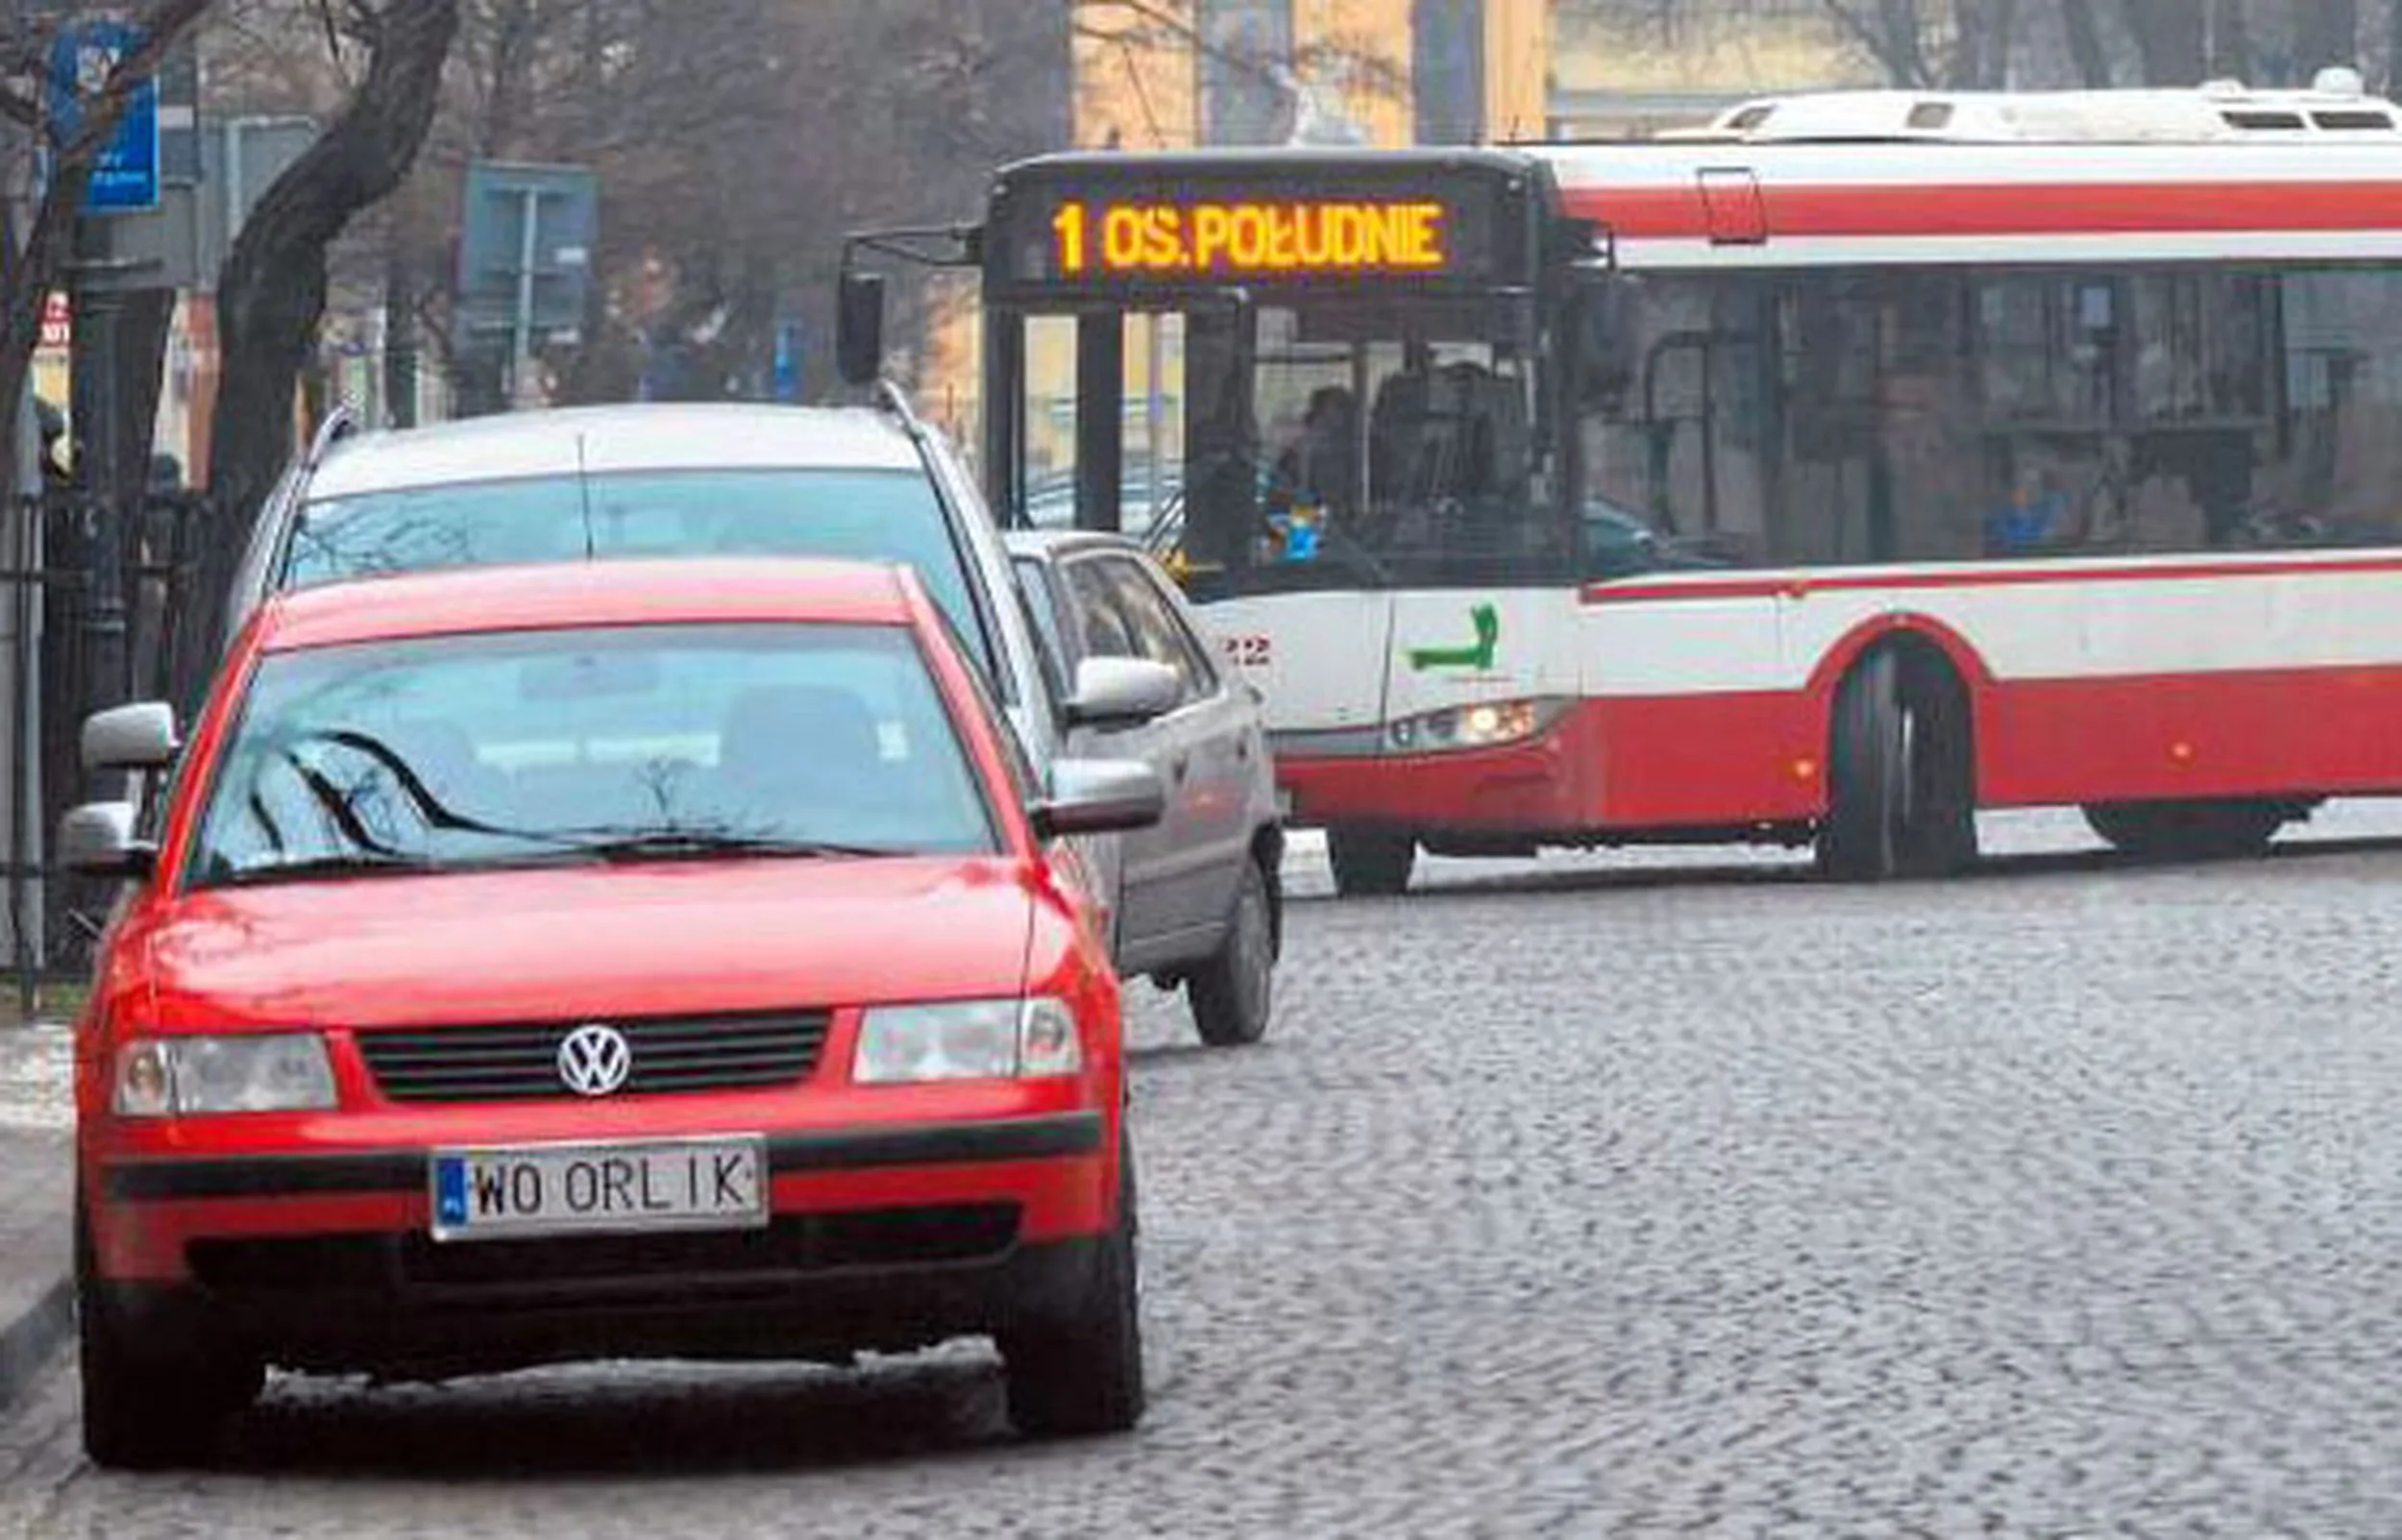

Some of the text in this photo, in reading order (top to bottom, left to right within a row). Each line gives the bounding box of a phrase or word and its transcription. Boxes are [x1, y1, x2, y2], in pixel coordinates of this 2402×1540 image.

[1053, 202, 1083, 270] 1
[559, 1024, 630, 1094] VW
[565, 1154, 746, 1210] ORLIK
